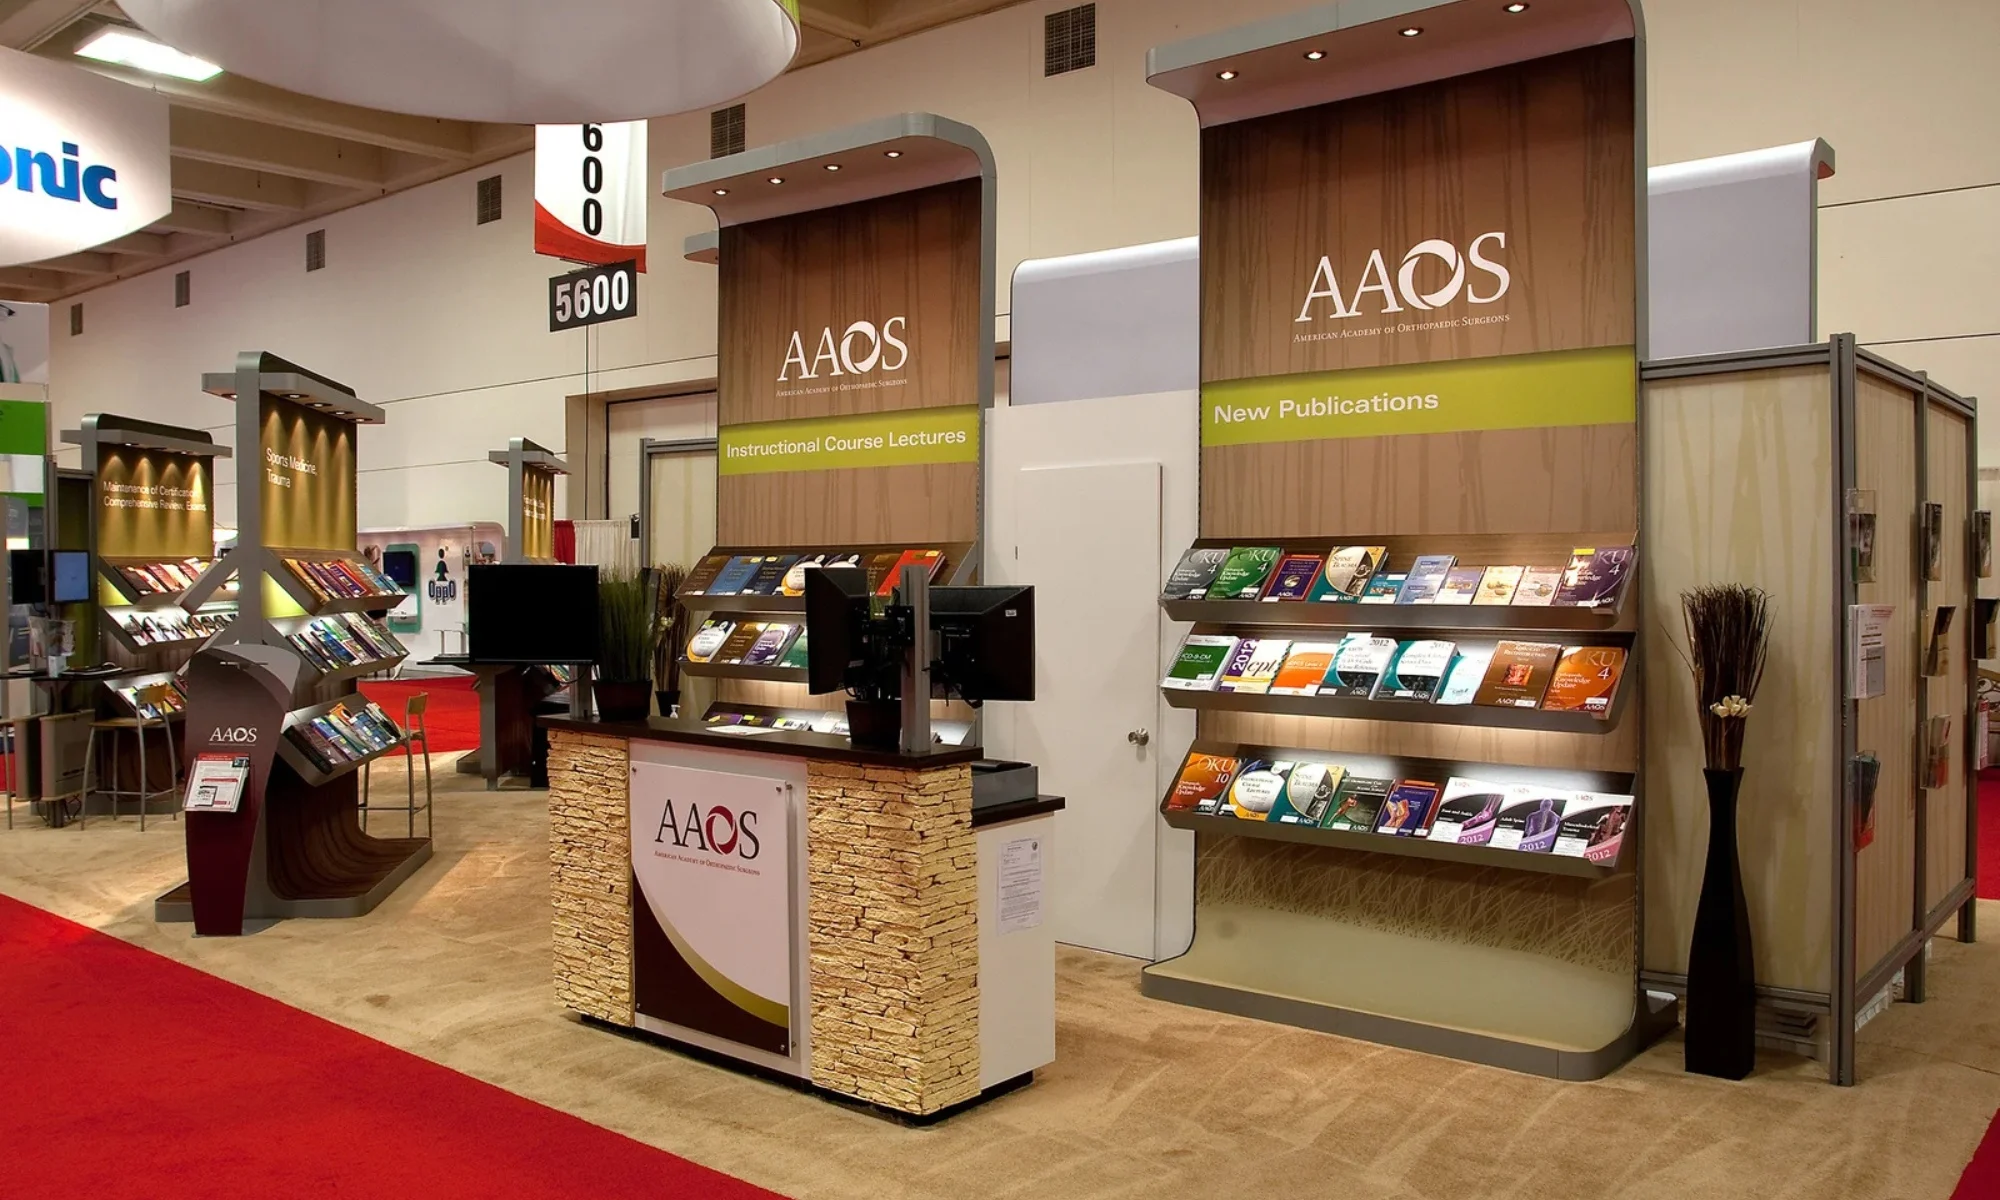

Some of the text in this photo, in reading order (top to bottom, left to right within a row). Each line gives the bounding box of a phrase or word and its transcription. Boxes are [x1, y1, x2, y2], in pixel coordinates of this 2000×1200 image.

[1294, 231, 1511, 323] AAOS
[555, 269, 630, 323] 5600
[777, 316, 908, 381] AAOS
[1214, 392, 1440, 424] New Publications
[726, 429, 966, 458] Instructional Course Lectures
[266, 447, 289, 468] Sports
[266, 468, 291, 488] Trauma
[103, 480, 150, 495] Maintenance
[151, 485, 158, 495] of
[103, 496, 159, 510] Comprehensive
[1207, 564, 1218, 574] 4
[1257, 562, 1268, 572] 4
[1608, 564, 1620, 575] 4
[1369, 639, 1389, 647] 2012
[1232, 640, 1257, 671] 2012
[1247, 660, 1277, 677] cpt
[1598, 667, 1610, 679] 4
[208, 727, 257, 743] AAOS
[1198, 757, 1236, 772] OKU
[1215, 773, 1229, 783] 10
[654, 799, 760, 860] AAOS
[1461, 834, 1484, 844] 2012
[1522, 841, 1546, 852] 2012
[1587, 850, 1611, 862] 2012
